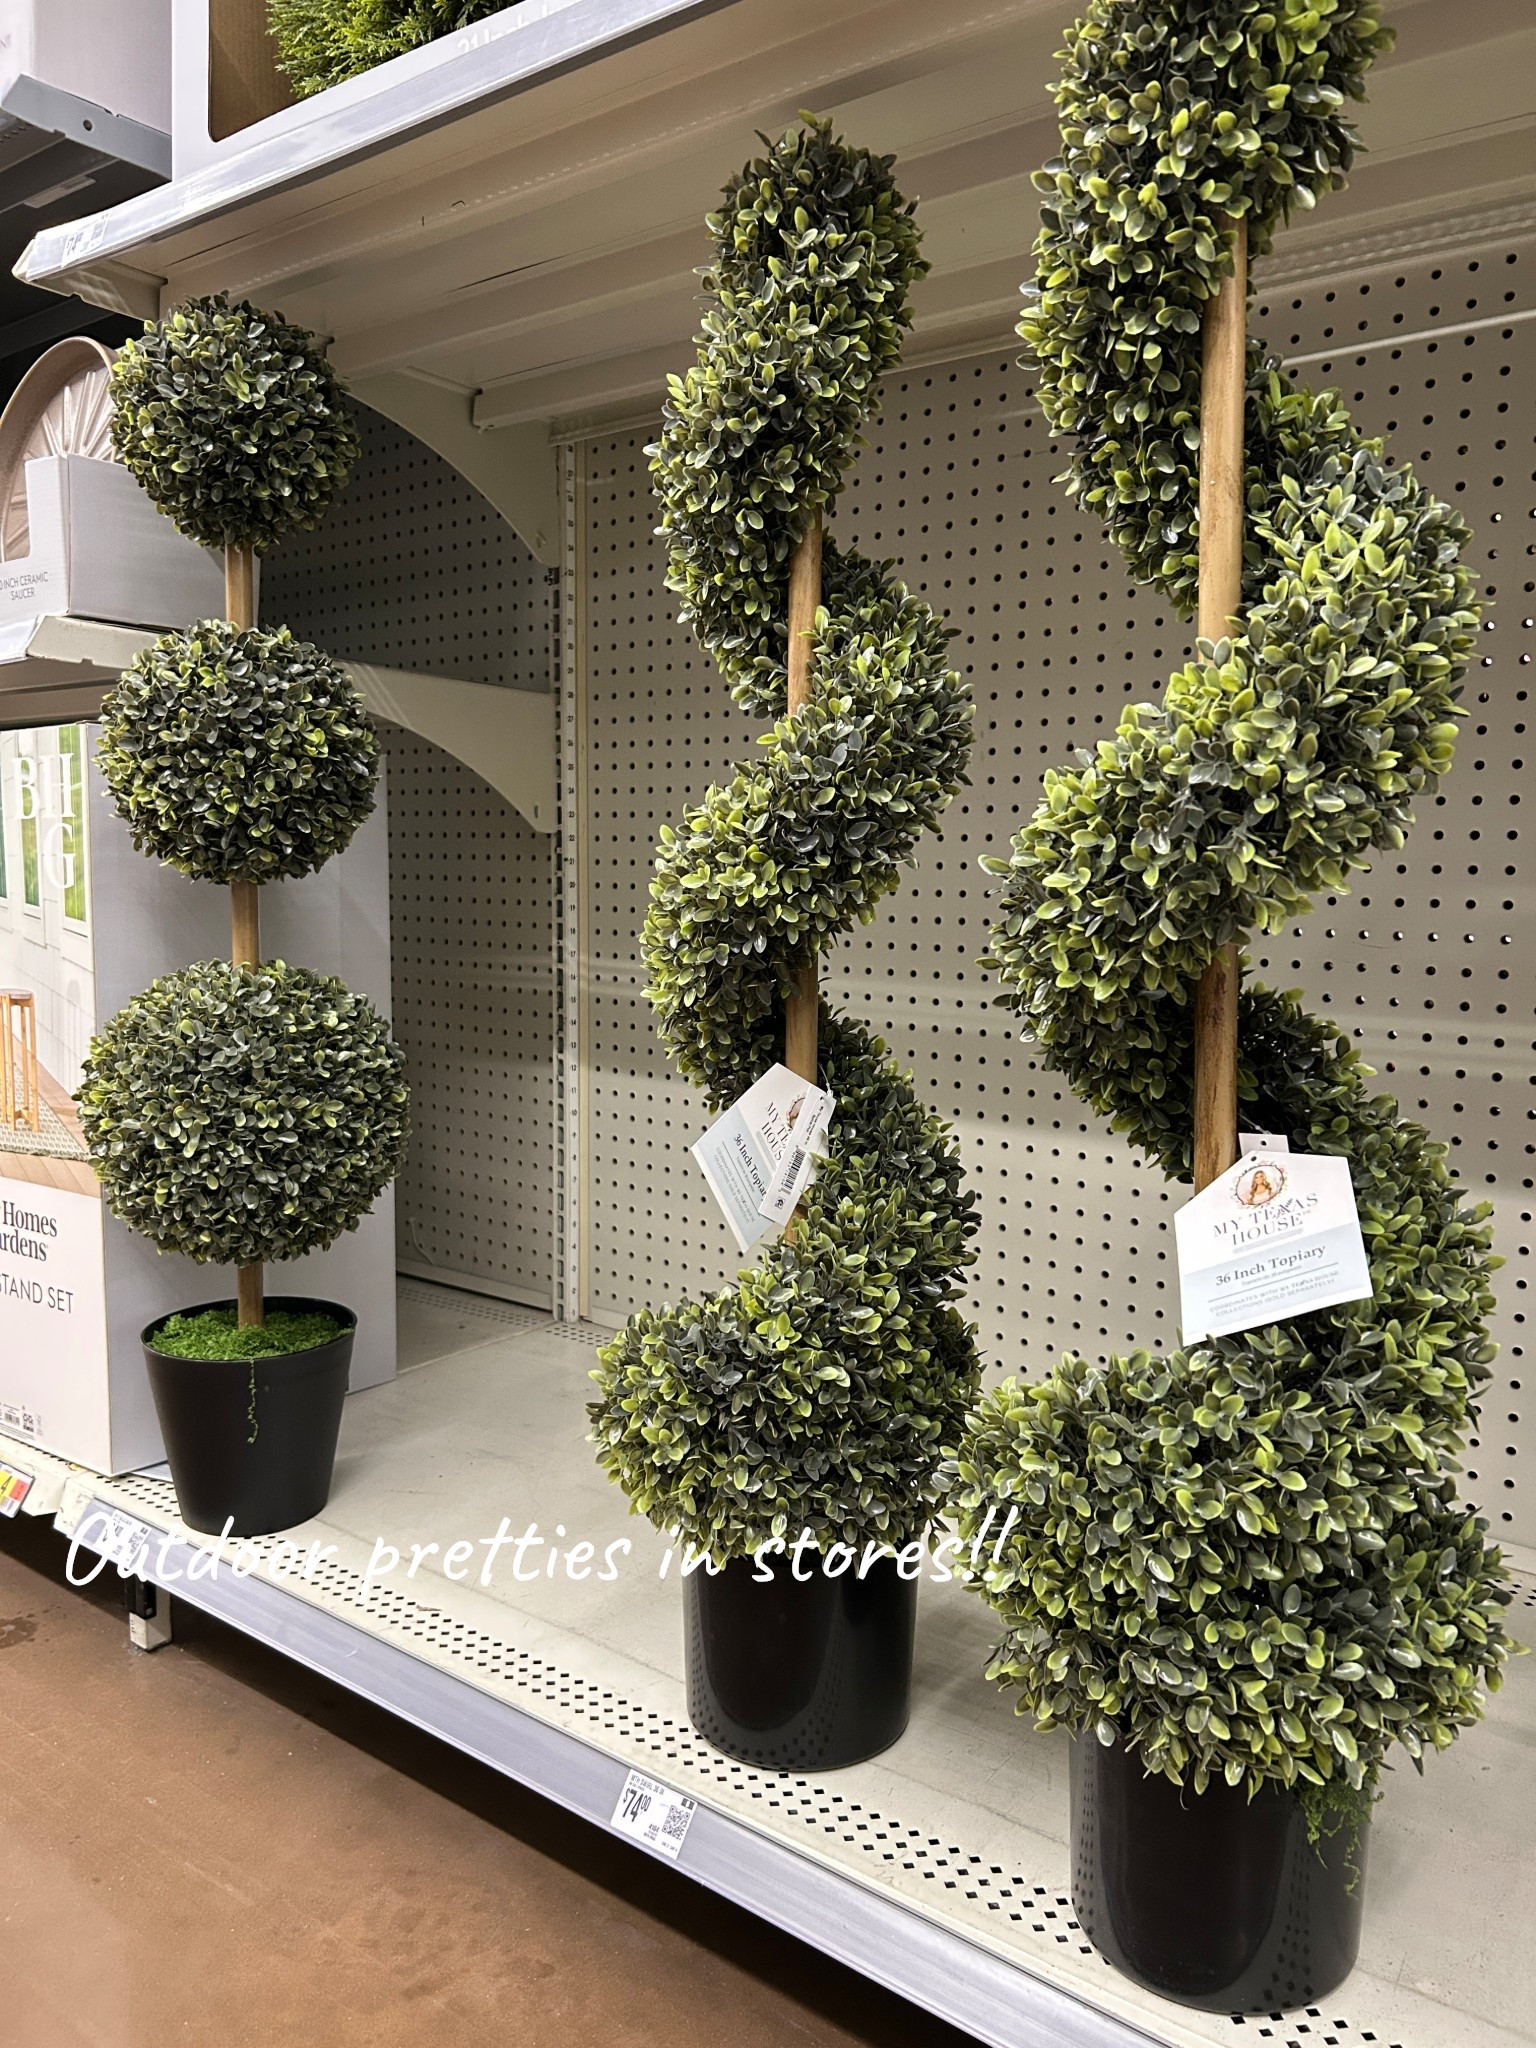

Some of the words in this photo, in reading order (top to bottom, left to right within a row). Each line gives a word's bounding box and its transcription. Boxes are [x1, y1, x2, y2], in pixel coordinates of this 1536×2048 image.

[4, 577, 18, 588] INCH
[20, 572, 48, 586] CERAMIC
[10, 587, 35, 600] SAUCER
[765, 1102, 778, 1124] MY
[734, 1133, 744, 1147] 36
[761, 1122, 785, 1162] HOUS
[738, 1144, 753, 1168] Inch
[749, 1163, 767, 1201] Topiar
[3, 1200, 58, 1238] Homes
[1213, 1217, 1244, 1238] MY
[1249, 1192, 1318, 1223] TEXAS
[1232, 1214, 1304, 1246] HOUSE
[1216, 1274, 1231, 1286] 36
[1234, 1264, 1265, 1280] Inch
[1268, 1246, 1326, 1270] Topiary
[48, 1286, 74, 1314] SET
